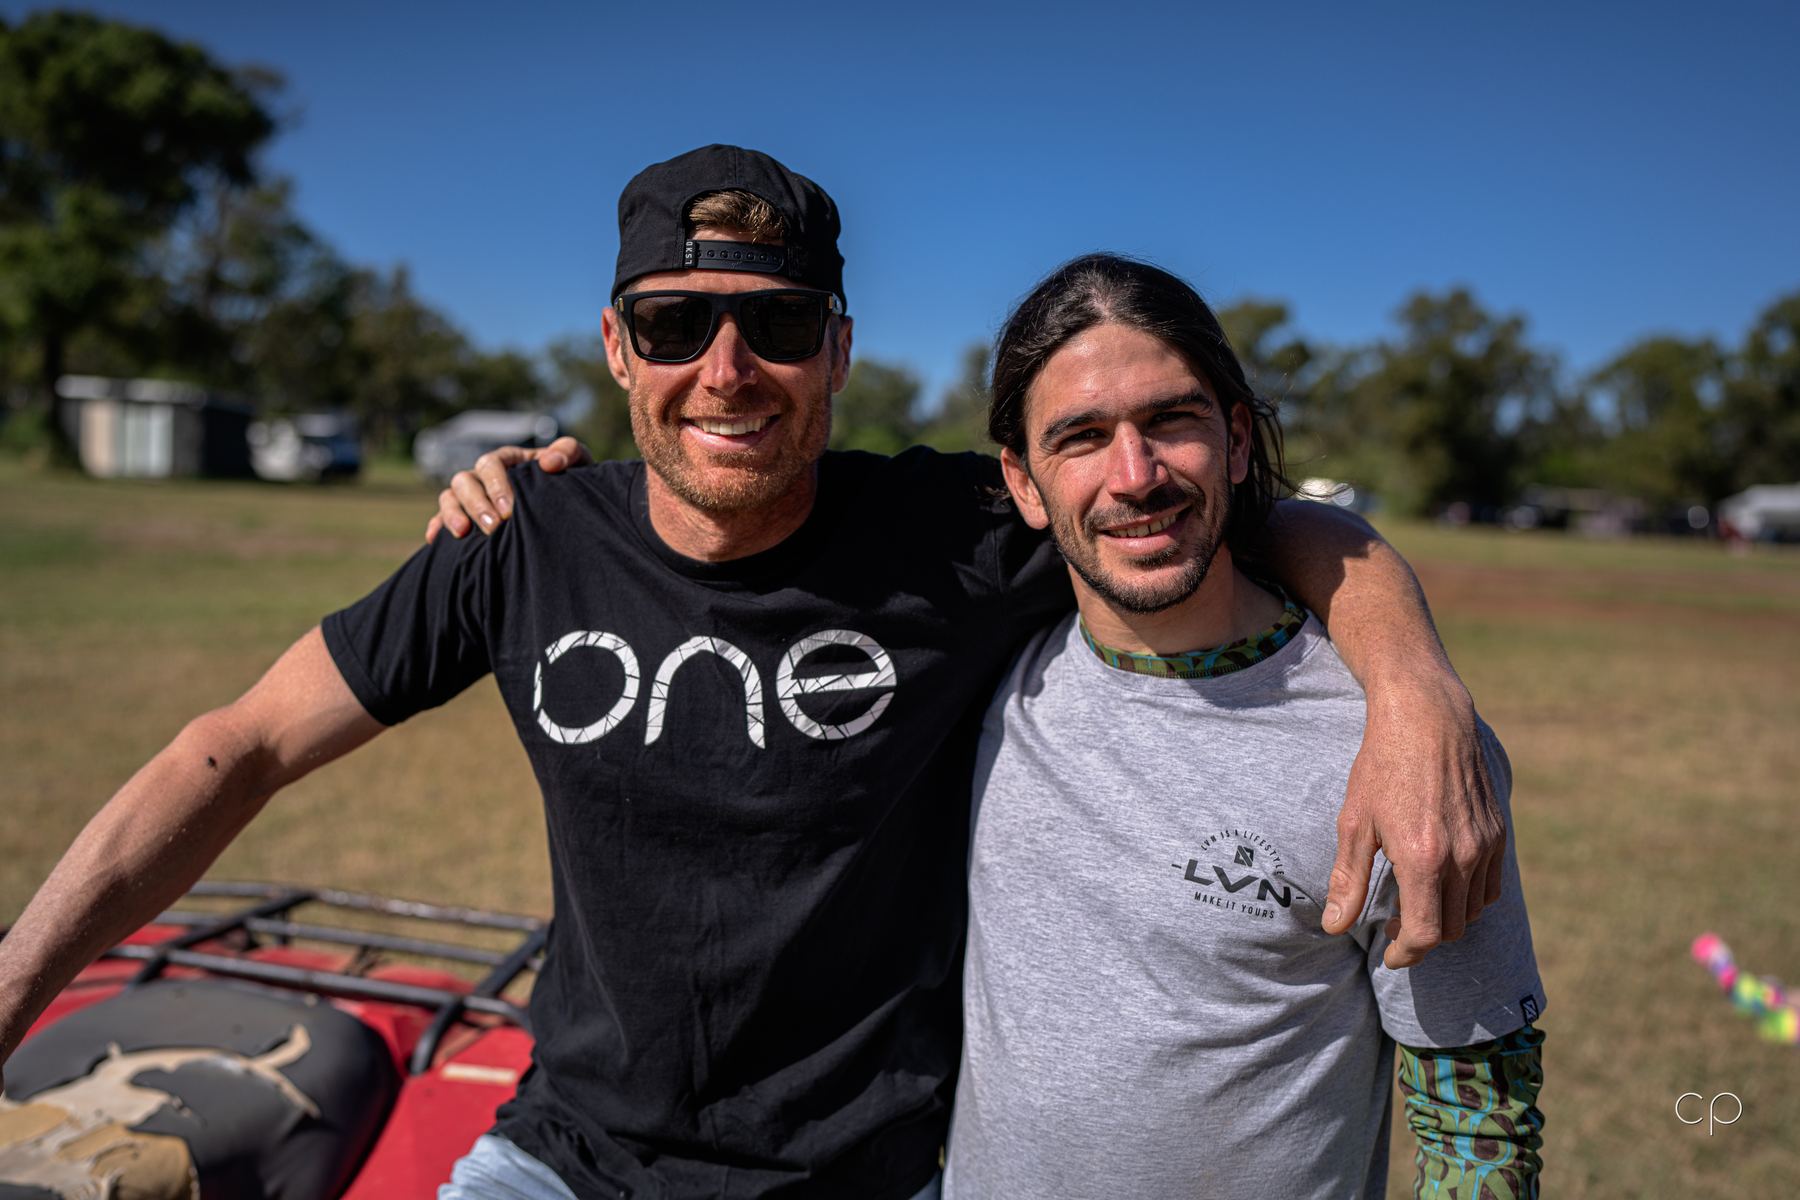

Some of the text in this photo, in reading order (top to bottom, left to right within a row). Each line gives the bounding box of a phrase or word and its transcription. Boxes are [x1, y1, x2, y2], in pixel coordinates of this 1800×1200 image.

[685, 241, 693, 265] LSKD
[533, 629, 897, 749] one
[1220, 829, 1230, 839] IS
[1243, 830, 1285, 875] LIFESTYLE
[1184, 858, 1292, 908] LVN
[1194, 891, 1275, 919] MAKE IT YOURS
